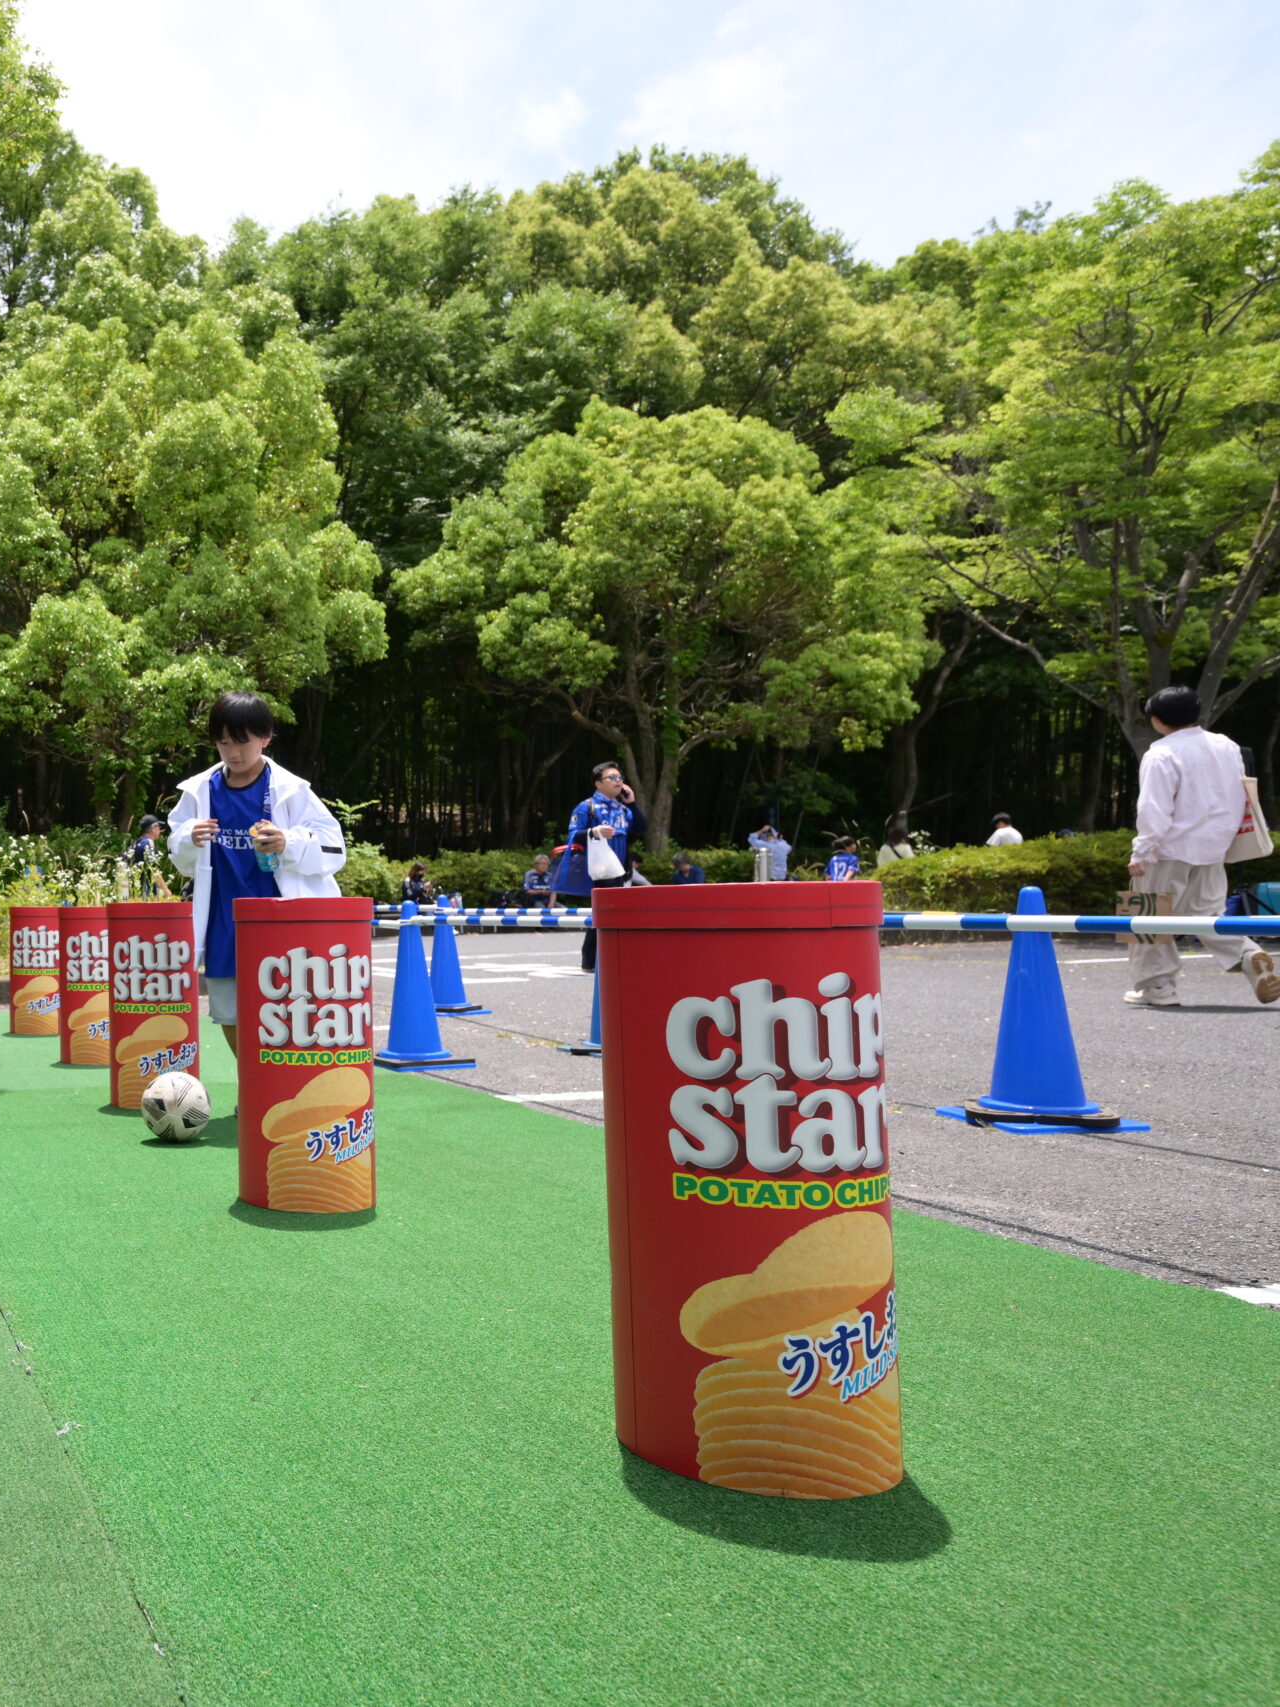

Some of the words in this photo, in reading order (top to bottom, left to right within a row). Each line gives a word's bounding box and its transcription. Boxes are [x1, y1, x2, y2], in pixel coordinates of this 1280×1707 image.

[13, 925, 60, 950] chip
[66, 929, 109, 960] chi
[113, 933, 191, 972] chip
[13, 947, 60, 969] star
[66, 956, 109, 982] sta
[258, 943, 371, 1001] chip
[67, 982, 103, 992] POTATO
[113, 967, 191, 1002] star
[114, 1003, 157, 1014] POTATO
[158, 1002, 192, 1014] CHIPS
[258, 996, 372, 1048] star
[665, 971, 885, 1081] chip
[260, 1048, 335, 1066] POTATO
[335, 1047, 372, 1065] CHIPS
[305, 1109, 376, 1162] うすしお
[668, 1073, 888, 1173] star
[673, 1172, 834, 1209] POTATO
[836, 1170, 892, 1209] CHIP
[779, 1291, 898, 1395] うすし
[840, 1350, 888, 1402] MILD
